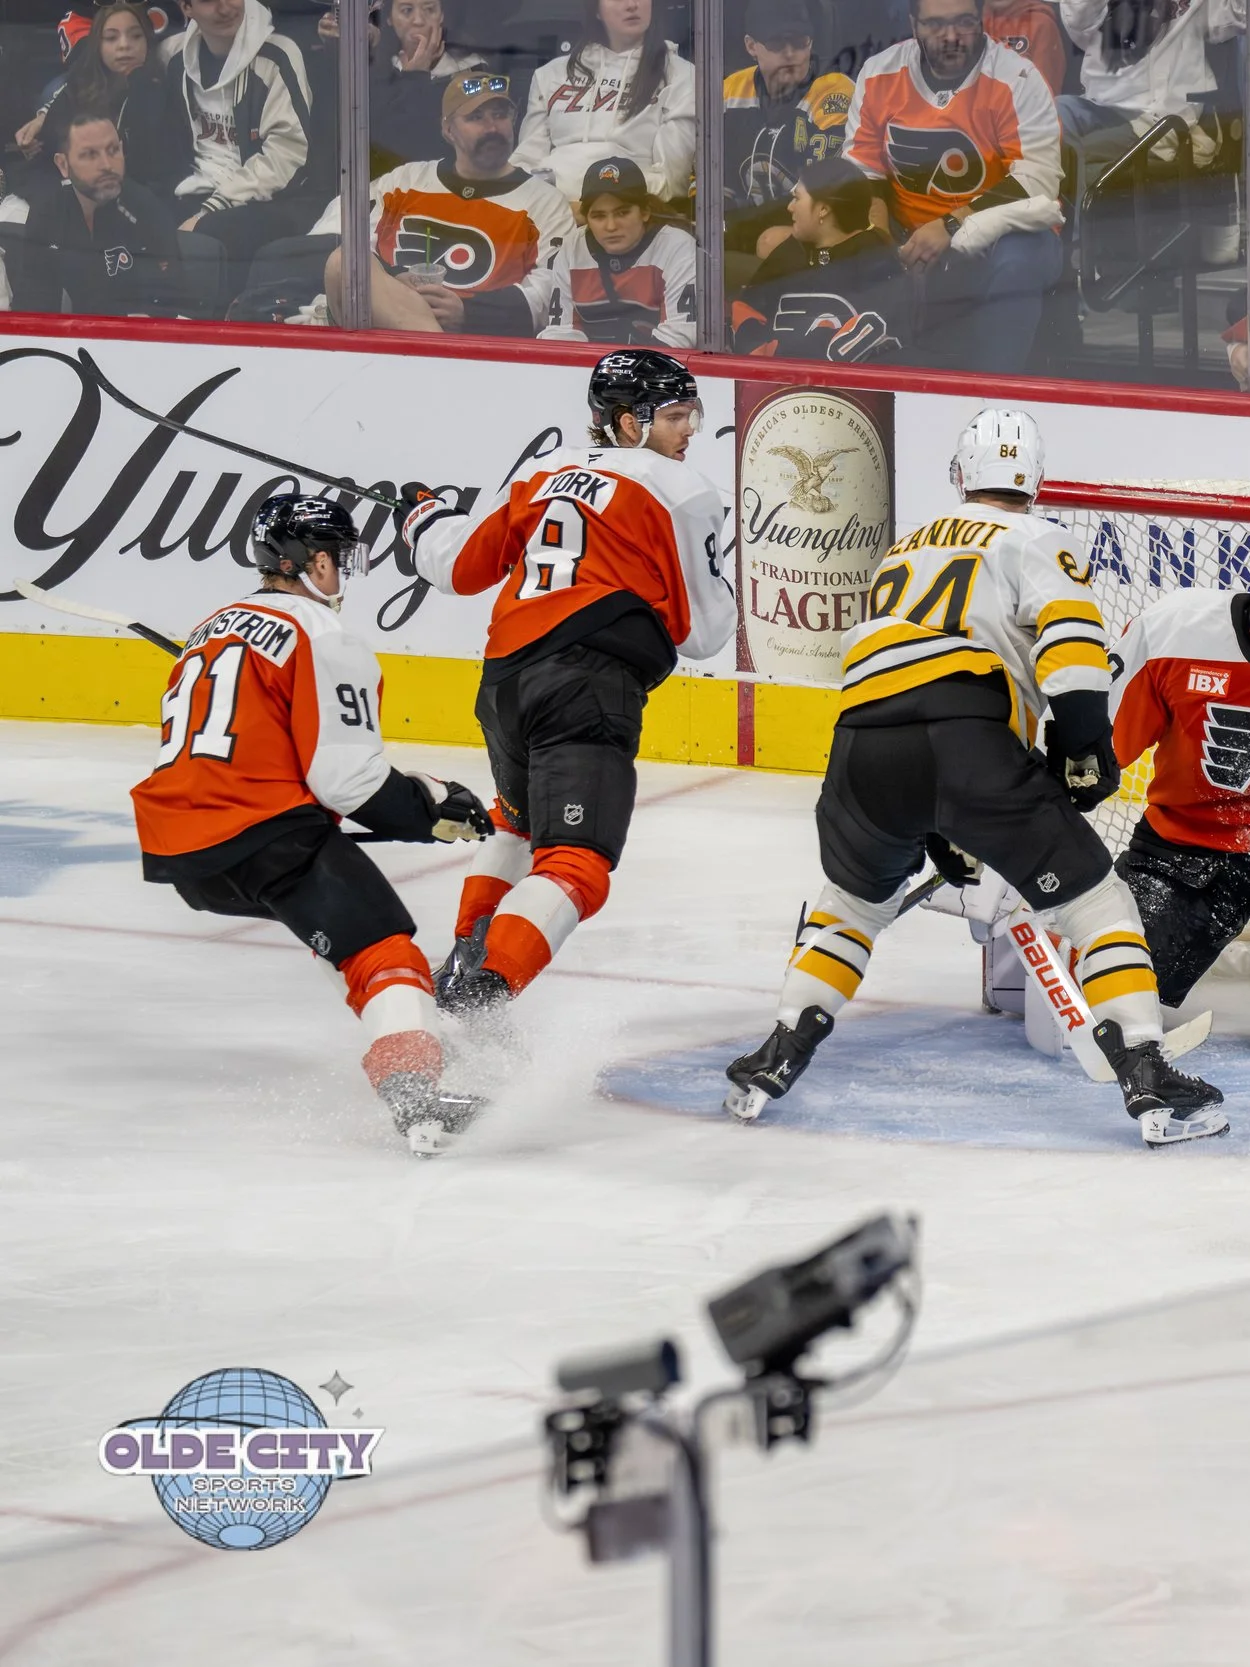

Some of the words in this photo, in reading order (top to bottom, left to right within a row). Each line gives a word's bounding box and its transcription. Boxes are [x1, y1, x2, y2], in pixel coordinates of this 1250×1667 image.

[748, 410, 788, 466] AMERICA'S
[793, 404, 843, 420] OLDEST
[847, 417, 881, 471] BREWERY
[1000, 444, 1017, 459] 84
[544, 472, 609, 506] YORK
[515, 496, 588, 600] 8
[741, 486, 890, 563] Yuengling
[887, 518, 1011, 557] EANNOT
[760, 560, 872, 586] TRADITIONAL
[870, 554, 982, 641] 84
[152, 642, 248, 773] 91
[335, 683, 376, 733] 91
[1187, 673, 1228, 696] IBX
